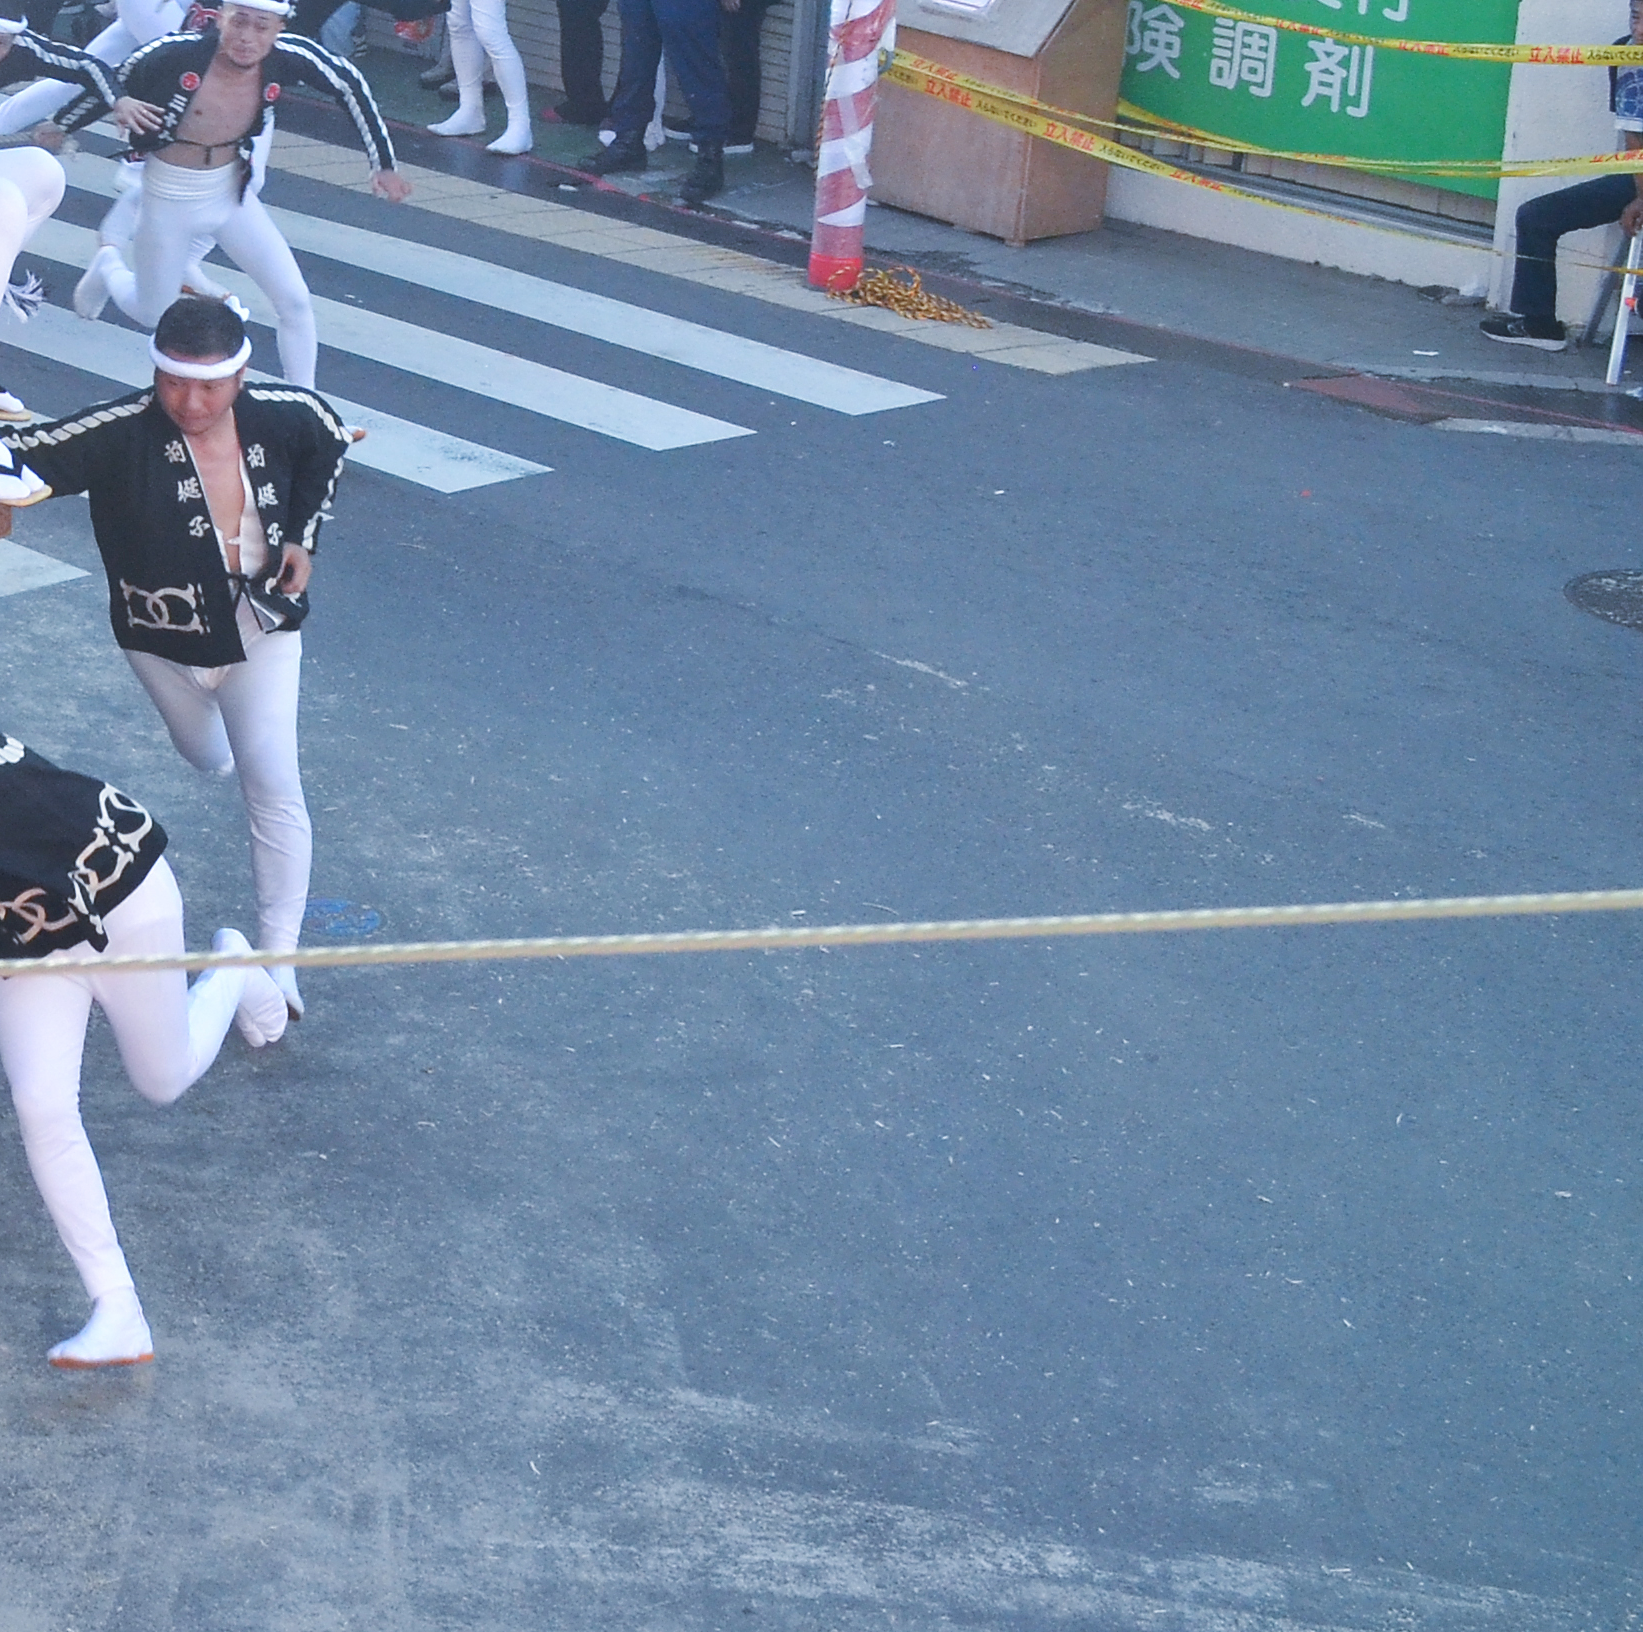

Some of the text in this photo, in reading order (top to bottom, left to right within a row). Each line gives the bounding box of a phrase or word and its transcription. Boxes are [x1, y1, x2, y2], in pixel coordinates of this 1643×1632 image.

[1528, 45, 1584, 64] 立入禁止
[924, 78, 973, 109] 立入禁止
[1042, 121, 1096, 152] 立入禁止
